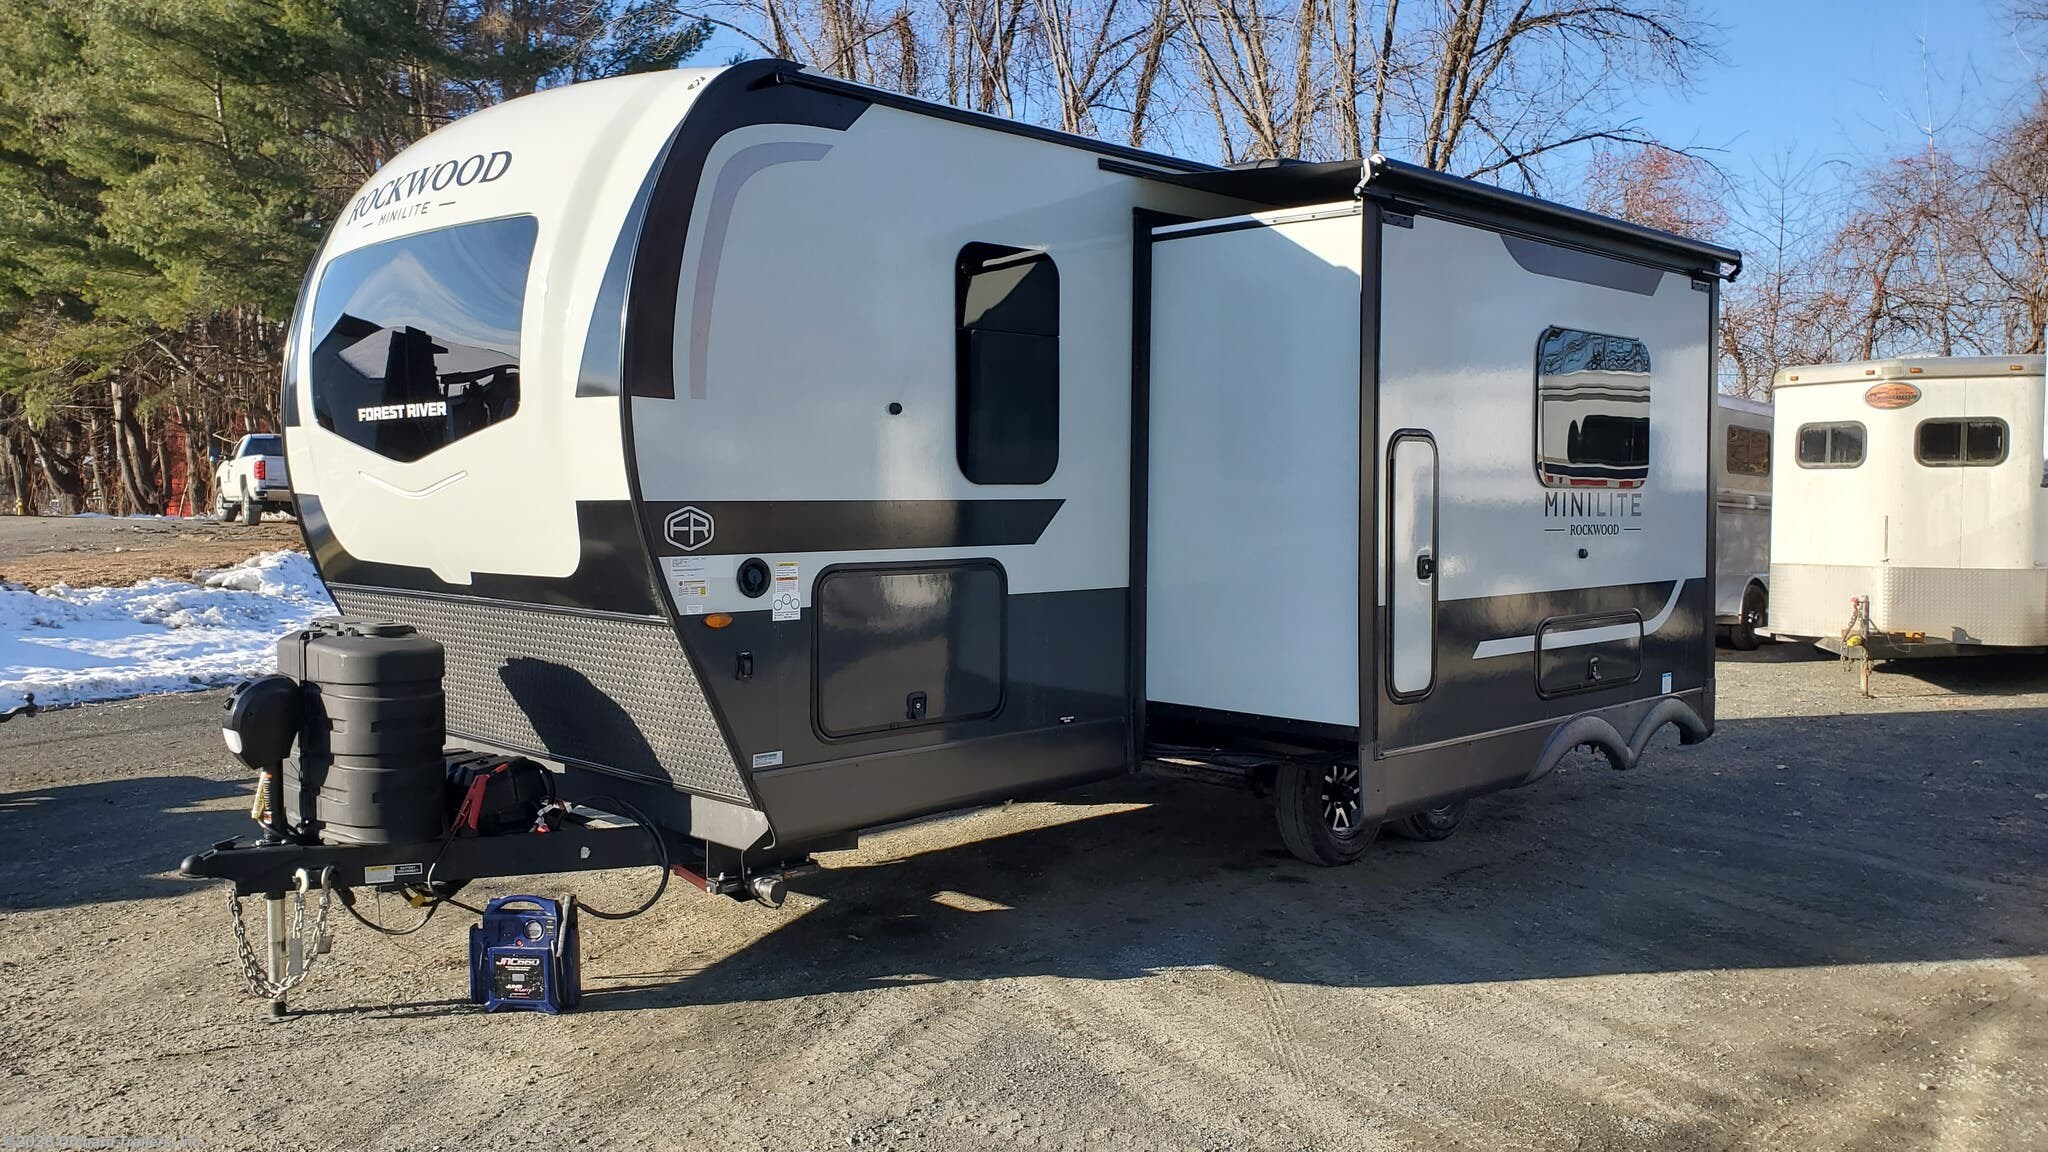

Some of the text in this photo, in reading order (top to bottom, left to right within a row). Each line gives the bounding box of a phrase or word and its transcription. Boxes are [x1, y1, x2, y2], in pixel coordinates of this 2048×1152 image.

[346, 150, 512, 227] ROCKWOOD
[378, 201, 431, 226] MINILITE
[357, 401, 447, 422] FOREST RIVER
[1545, 491, 1642, 517] MINILITE
[1570, 524, 1620, 536] ROCKWOOD
